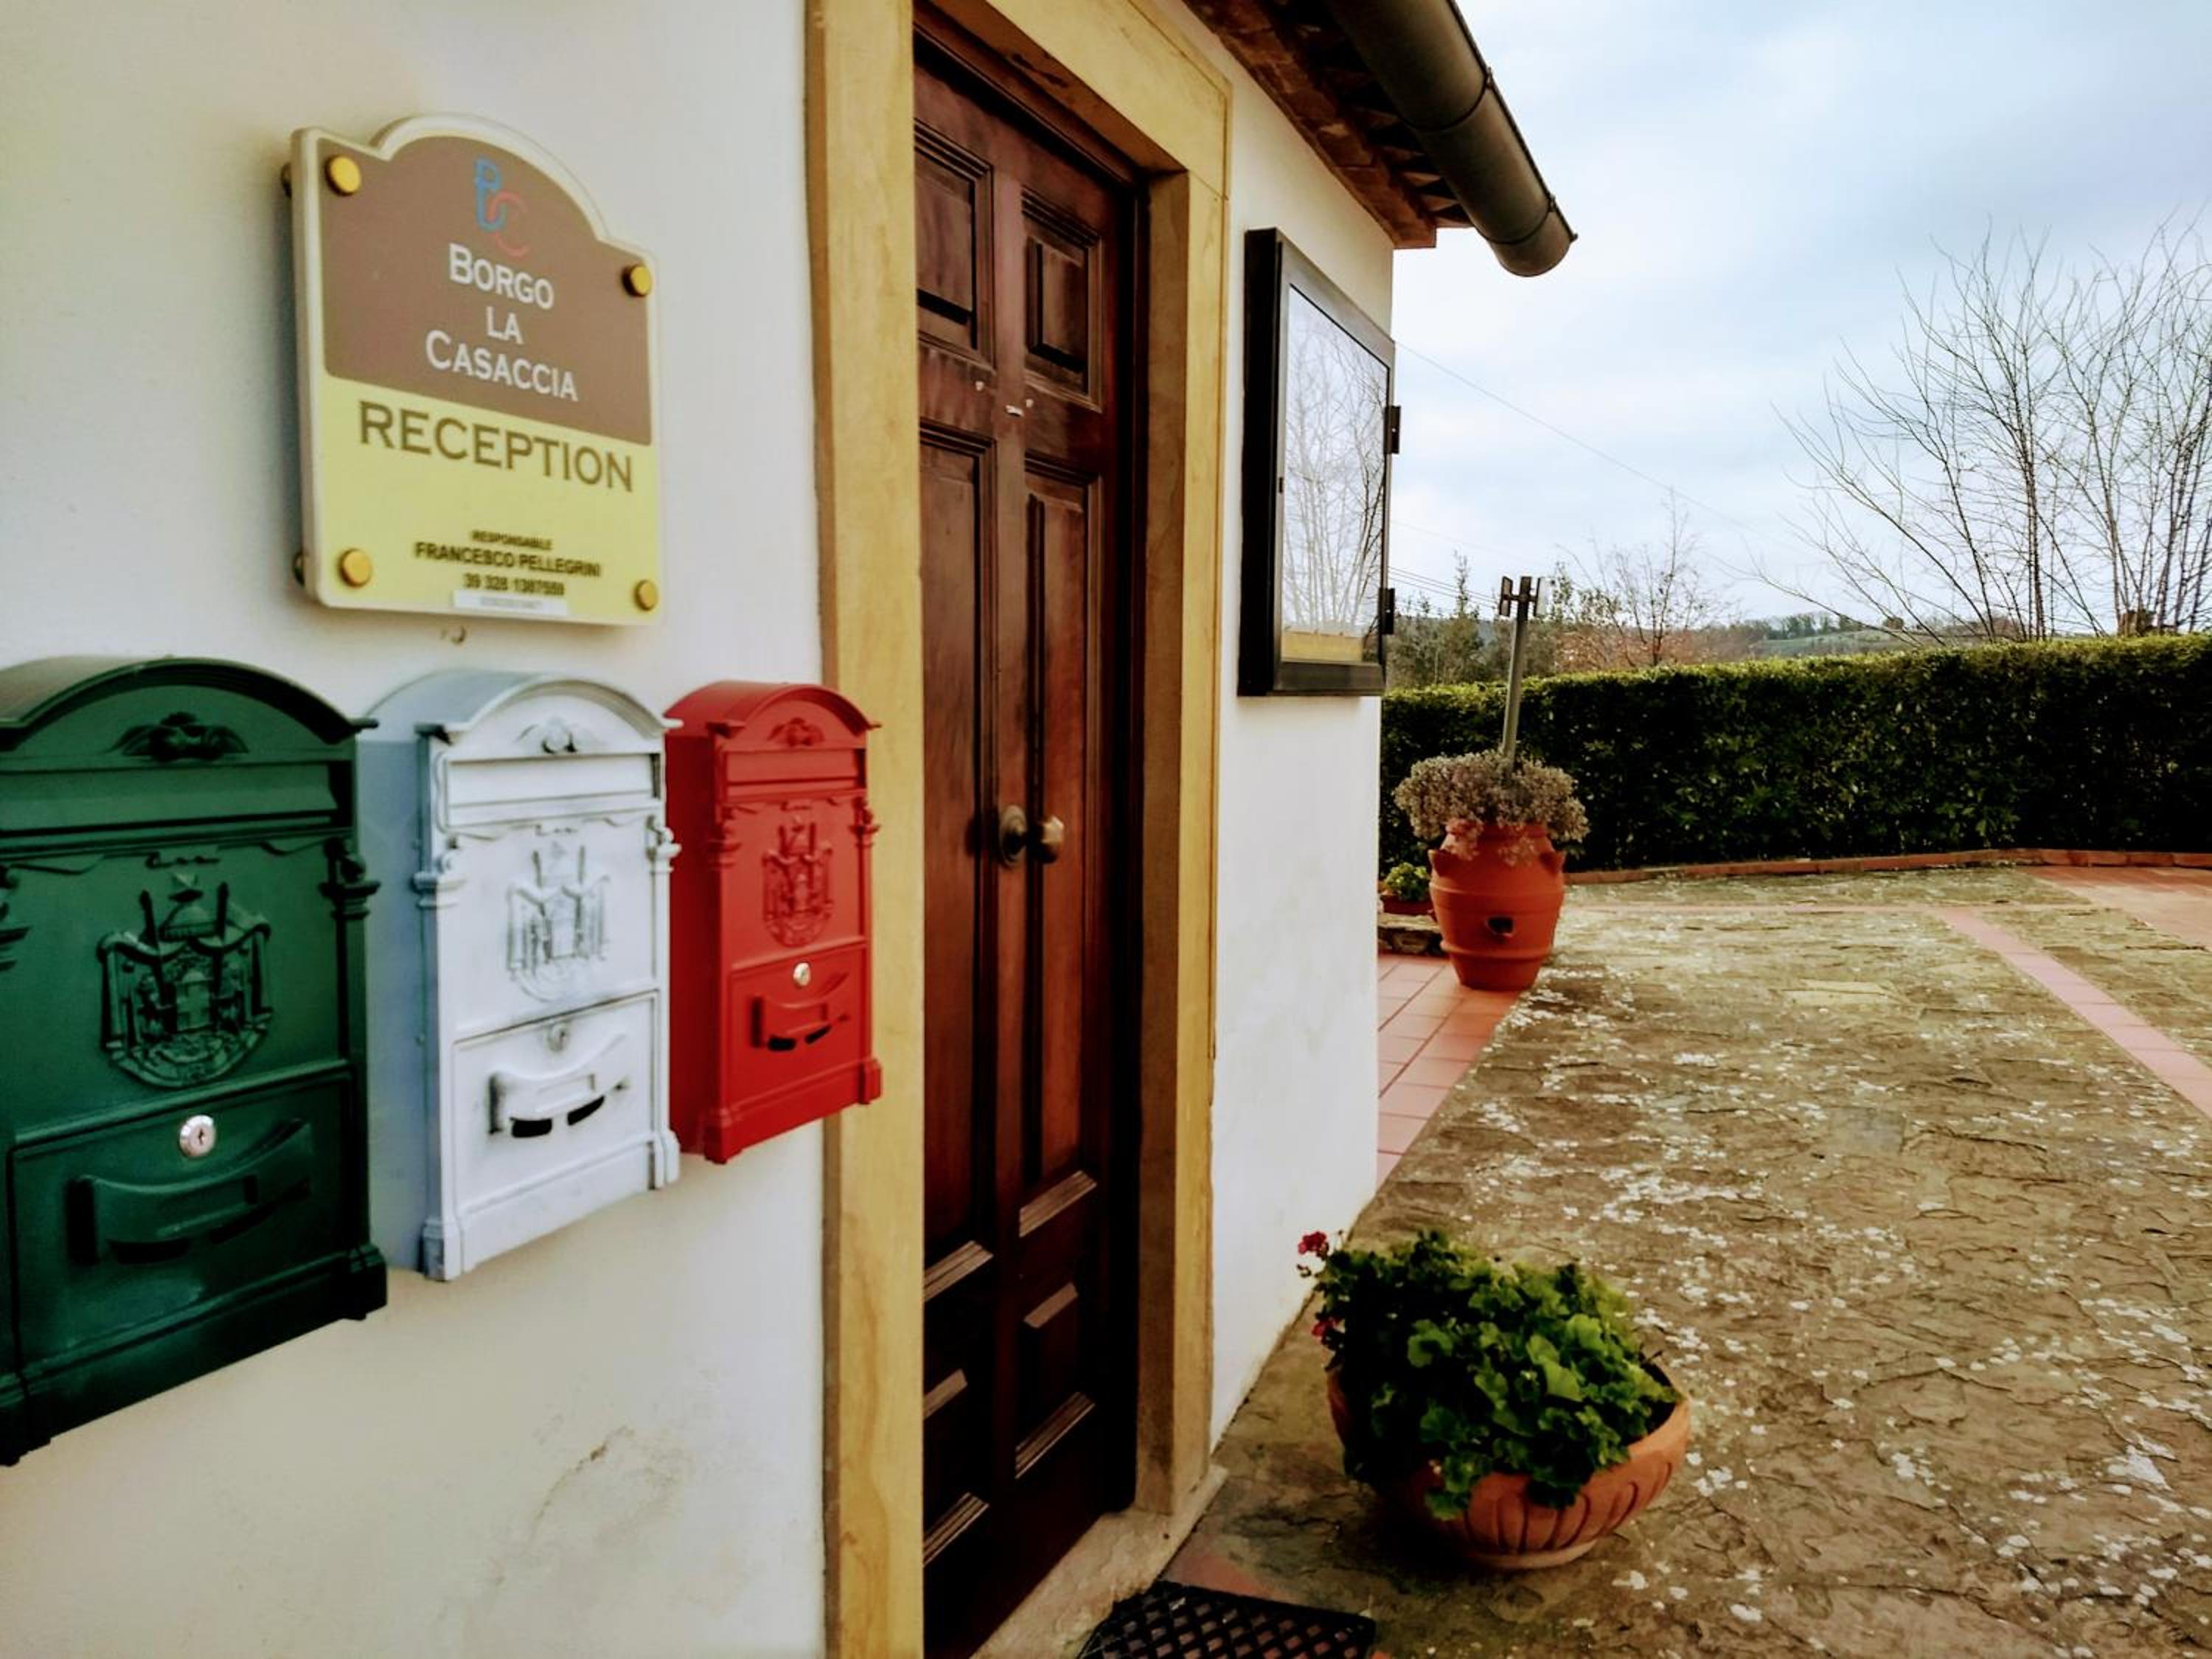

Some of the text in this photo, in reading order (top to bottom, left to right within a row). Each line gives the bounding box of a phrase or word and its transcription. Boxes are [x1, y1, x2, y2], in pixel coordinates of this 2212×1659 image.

[486, 306, 524, 345] LA
[358, 400, 634, 492] RECEPTION
[415, 542, 601, 577] FRANCESCO PELLEGRINI
